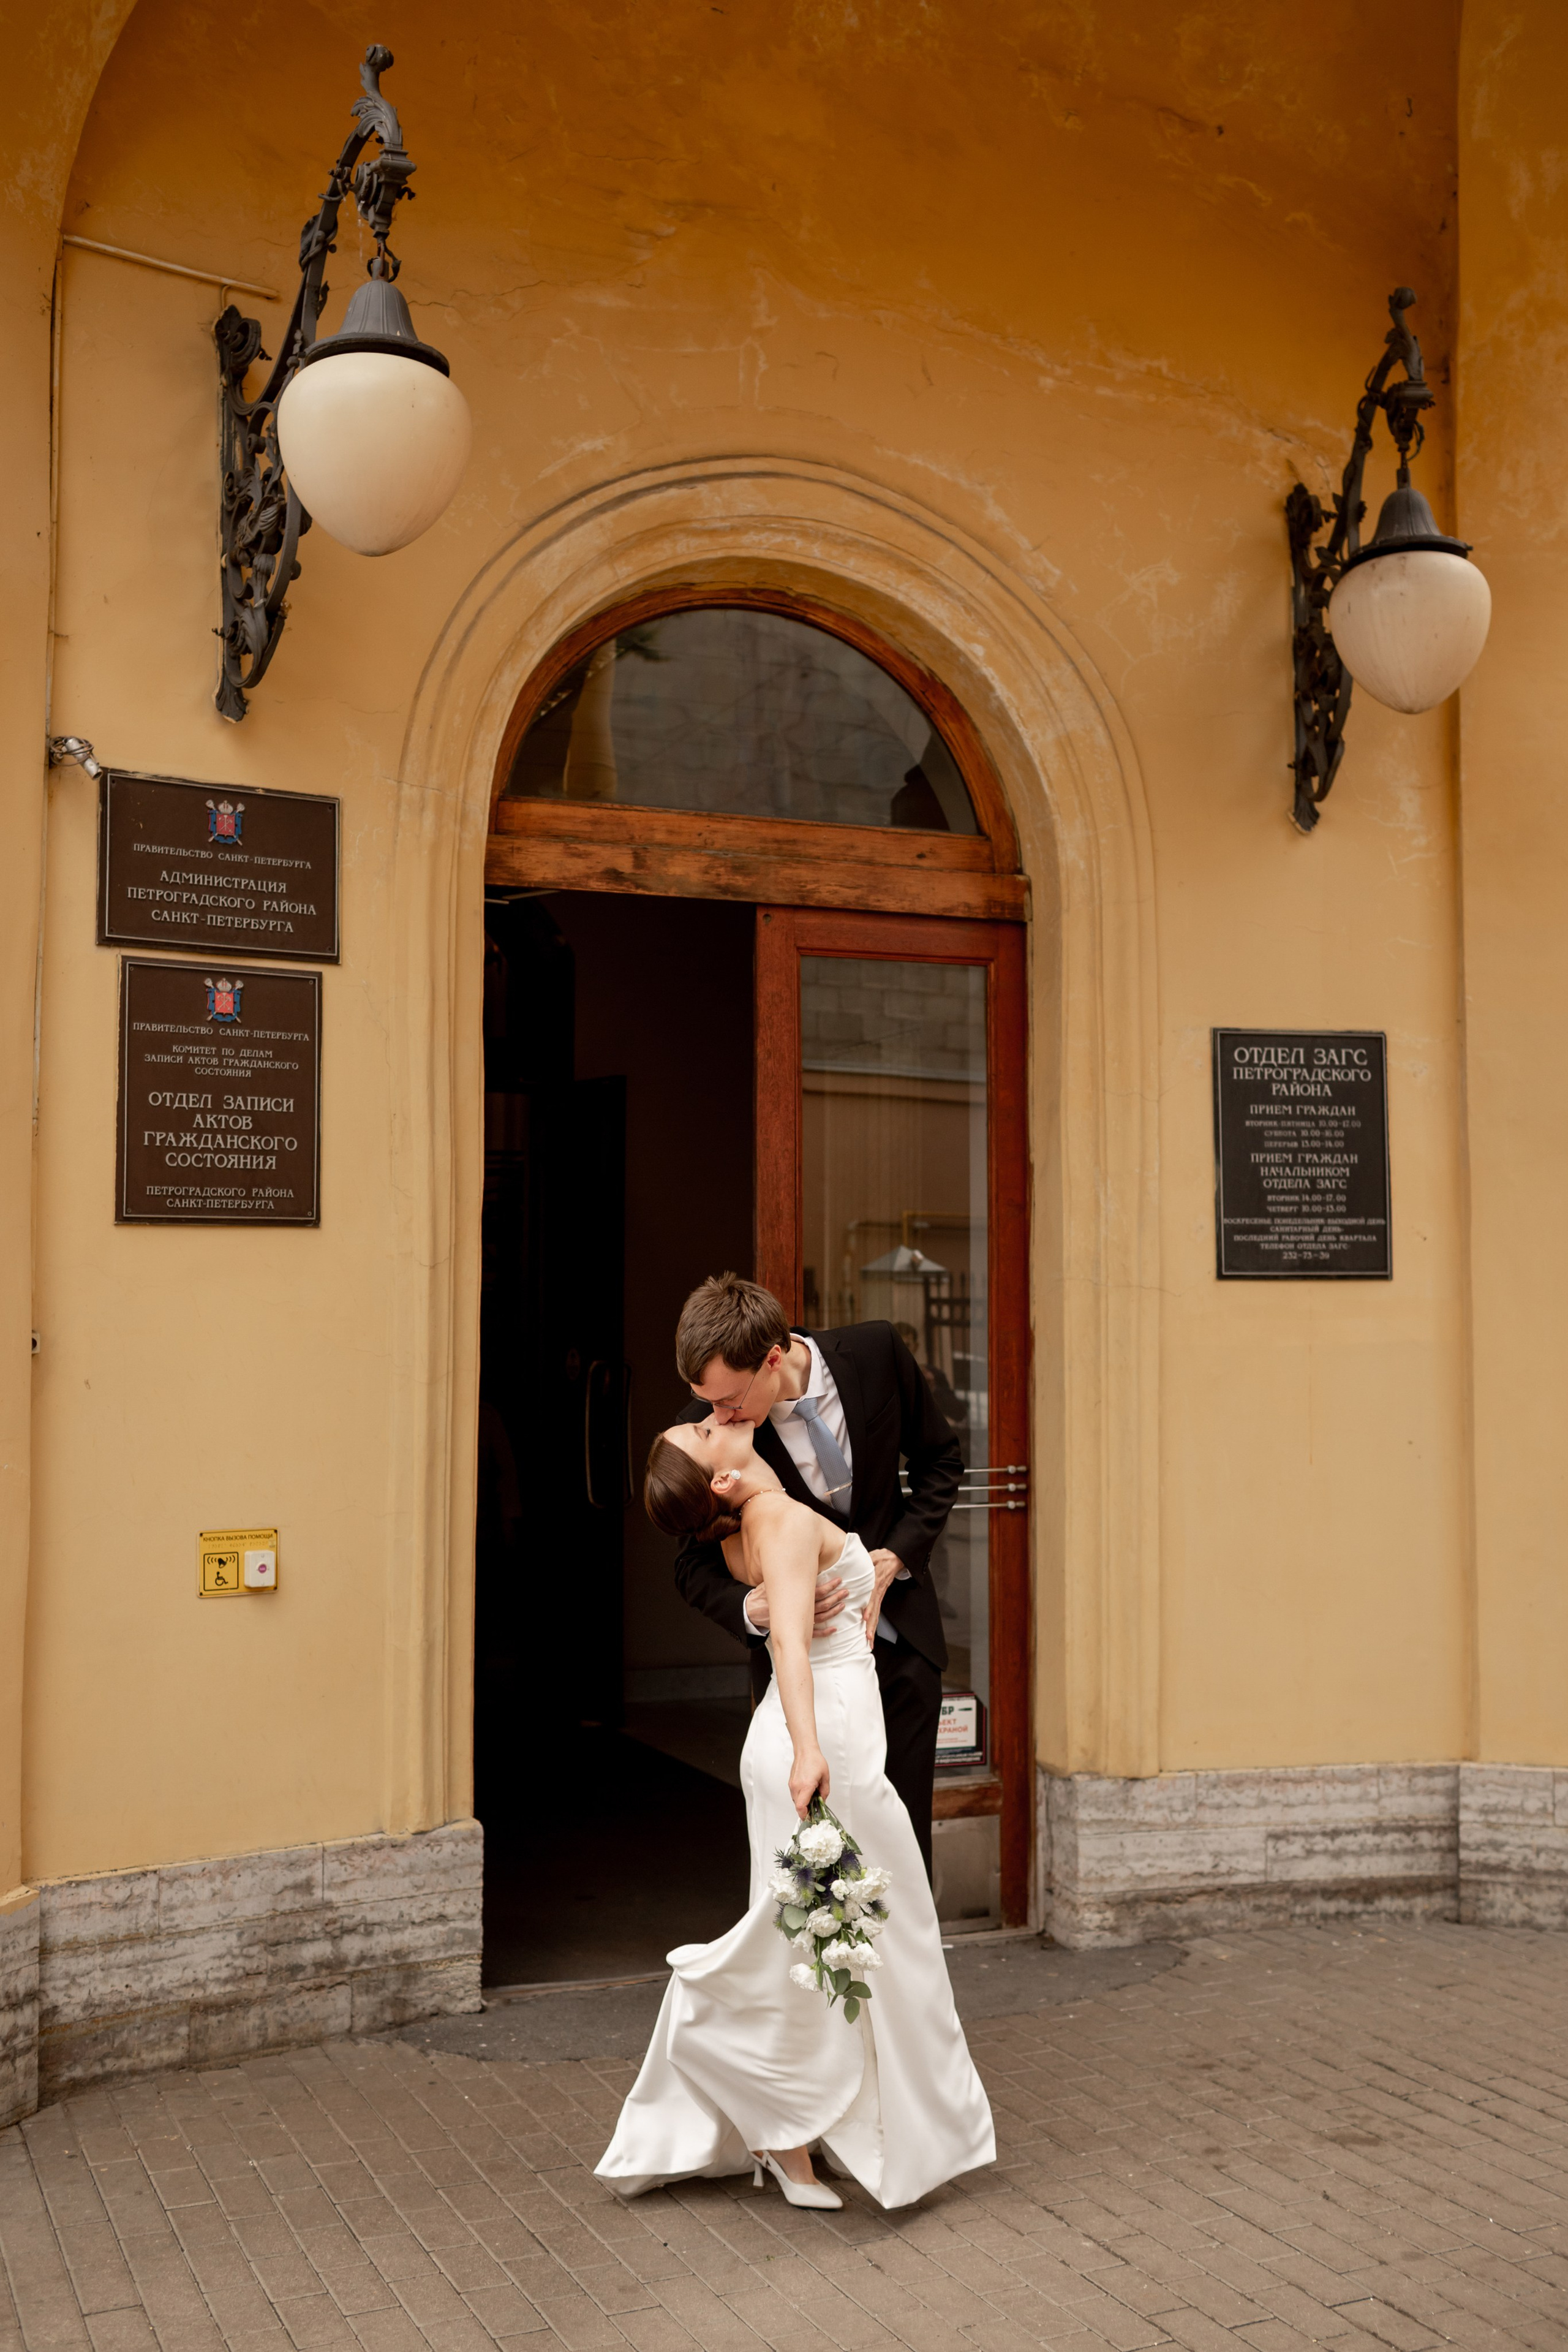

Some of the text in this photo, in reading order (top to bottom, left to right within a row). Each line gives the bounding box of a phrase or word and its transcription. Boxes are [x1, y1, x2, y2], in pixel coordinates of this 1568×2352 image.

[134, 843, 312, 869] ПРАВИТЕЛЬСТВО САНКТ-ПЕТЕРБУРГА
[160, 870, 287, 893] АДМИНИСТРАЦИЯ
[127, 887, 317, 915] ПЕТРОГРАДСКОГО РАЙОНА
[151, 909, 294, 933] САНКТ-ПЕТЕРБУРГА
[133, 1022, 309, 1042] ПРАВИТЕЛЬСТВО САНКТ-ПЕТЕРБУРГА
[172, 1045, 273, 1058] КОМИТЕТ ПО ДЕЛАМ
[1234, 1046, 1368, 1067] ОТДЕЛ ЗАГС
[144, 1054, 299, 1070] ЗАПИСИ АКТОВ ГРАЖДАНСКОГО
[194, 1067, 252, 1078] СОСТОЯНИЯ
[1233, 1067, 1371, 1083] ПЕТРОГРАДСКОГО
[1272, 1081, 1332, 1097] РАЙОНА
[148, 1091, 294, 1113] ОТДЕЛ ЗАПИСИ
[1250, 1104, 1355, 1117] ПРИЕМ ГРАЖДАН
[192, 1113, 253, 1130] АКТОВ
[143, 1131, 298, 1151] ГРАЖДАНСКОГО
[165, 1152, 277, 1170] СОСТОЯНИЯ
[1251, 1152, 1358, 1165] ПРИЕМ ГРАЖДАН
[1260, 1166, 1350, 1177] НАЧАЛЬНИКОМ
[146, 1185, 295, 1198] ПЕТРОГРАДСКОГО РАЙОНА
[1262, 1178, 1347, 1190] ОТДЕЛА ЗАГС
[166, 1198, 274, 1209] САНКТ-ПЕТЕРБУРГА
[941, 1706, 954, 1715] БР
[938, 1725, 968, 1734] ХРАНОЙ
